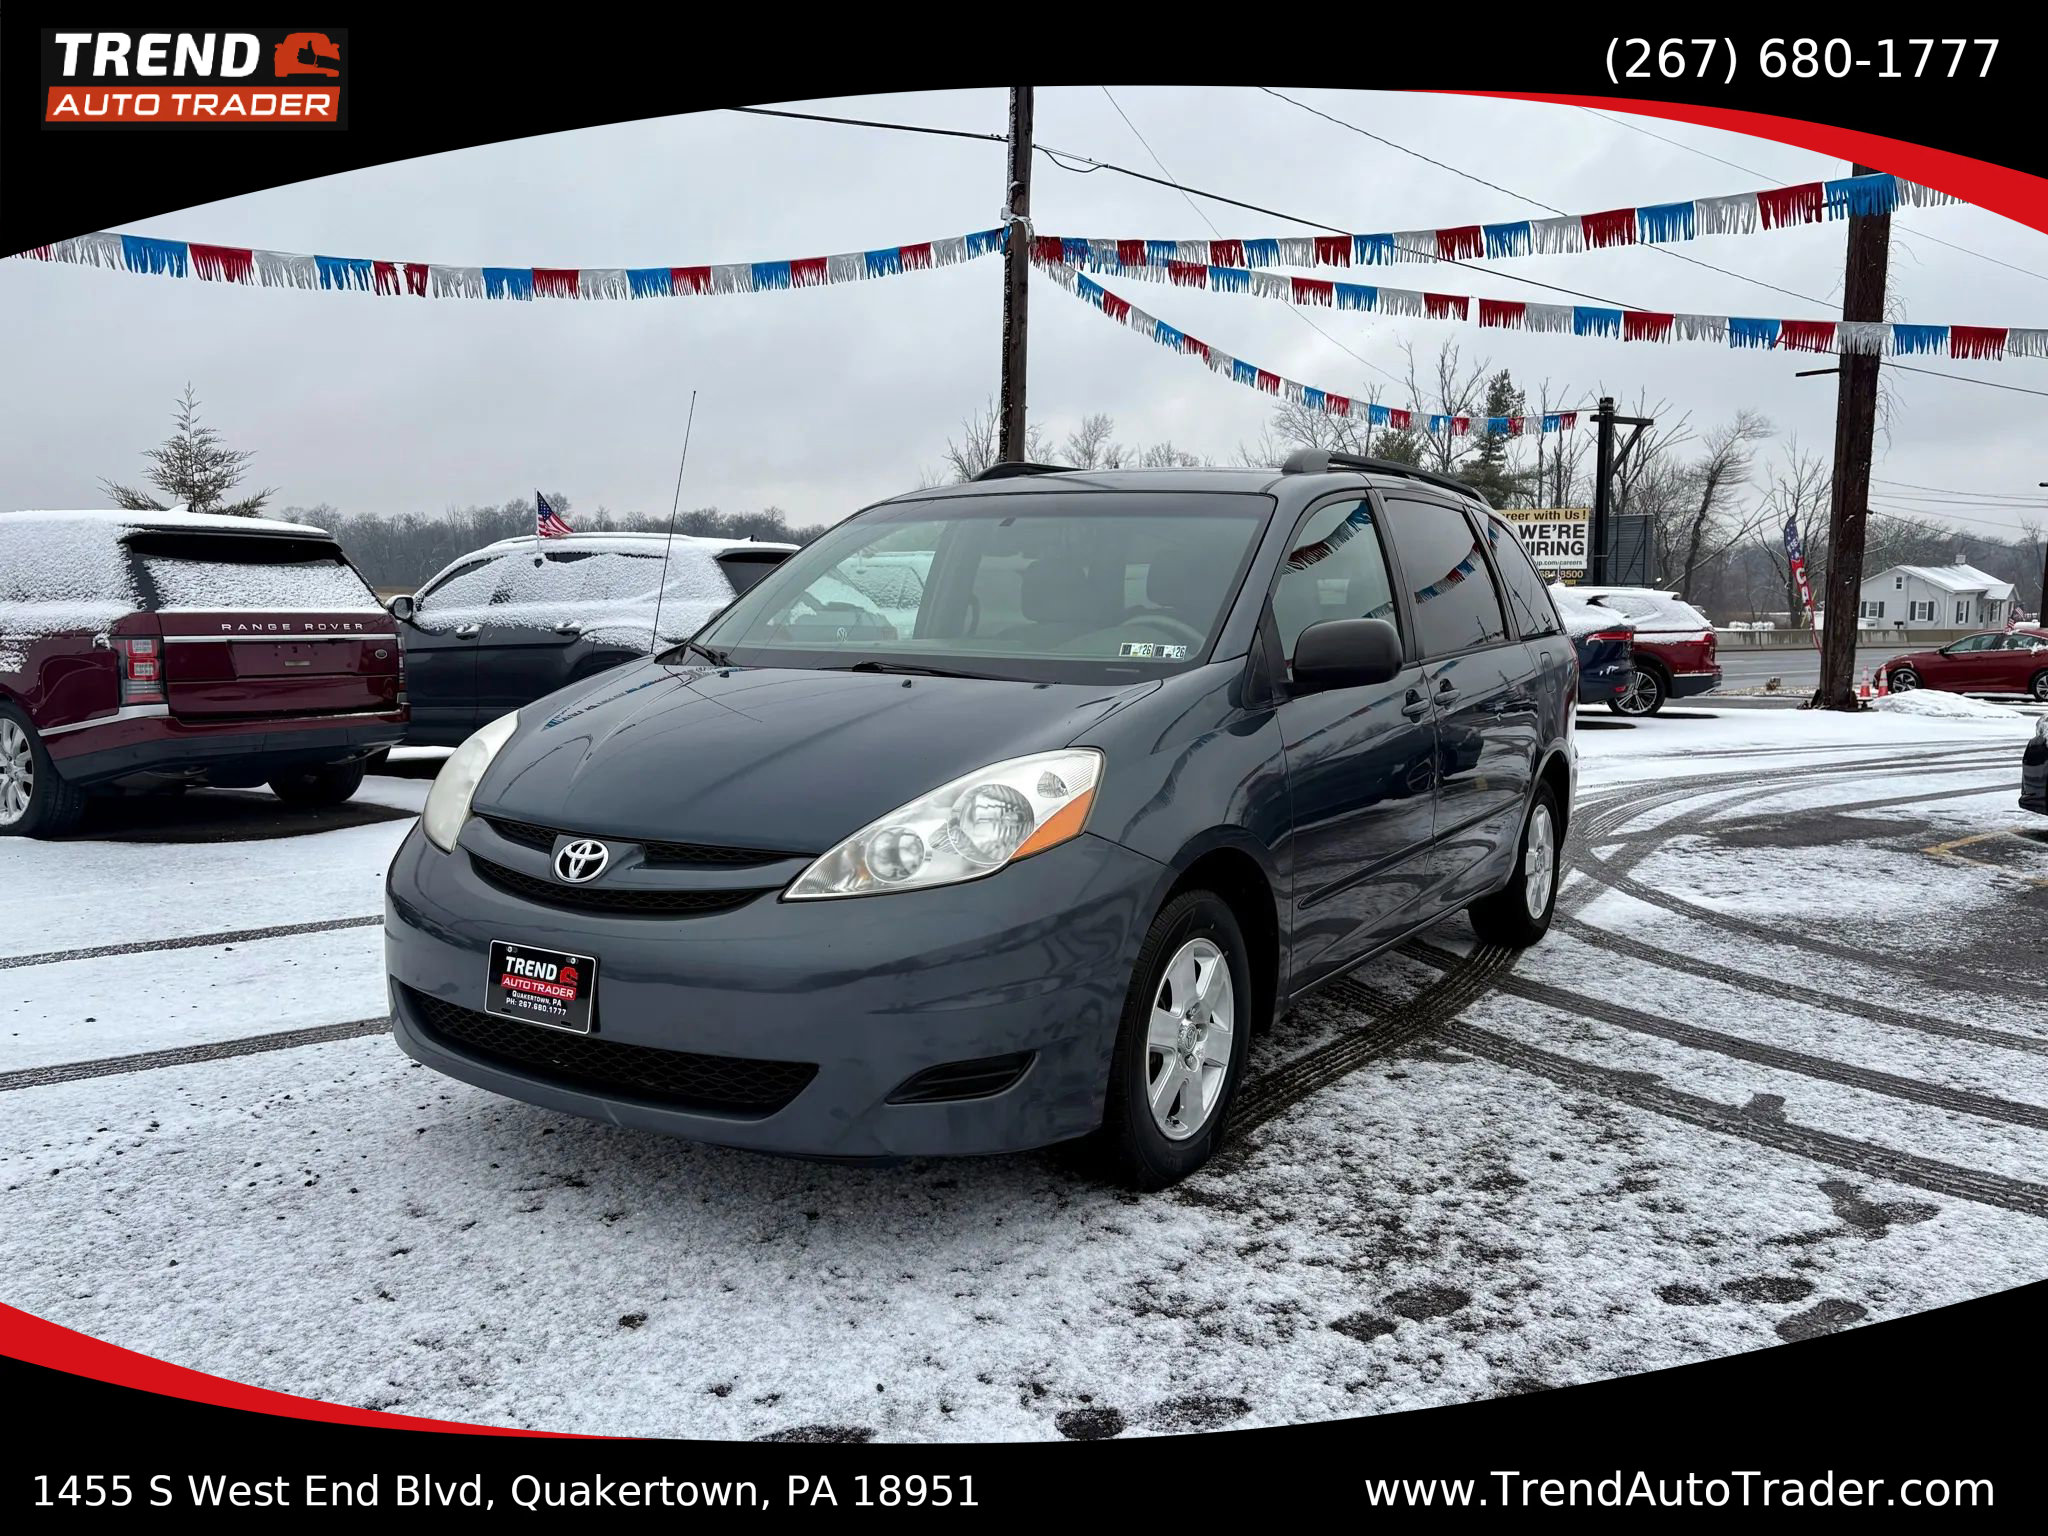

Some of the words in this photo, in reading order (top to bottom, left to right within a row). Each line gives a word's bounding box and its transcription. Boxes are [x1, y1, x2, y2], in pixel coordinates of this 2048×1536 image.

[1503, 512, 1530, 520] reer
[1534, 510, 1560, 520] with
[1518, 524, 1585, 539] WE'RE
[221, 623, 291, 631] RANGE
[304, 623, 363, 631] ROVER
[505, 955, 558, 981] TREND
[502, 977, 531, 990] AUTO
[532, 982, 574, 999] TRADER
[506, 997, 517, 1006] PH:
[519, 1000, 567, 1015] 267.680.1777
